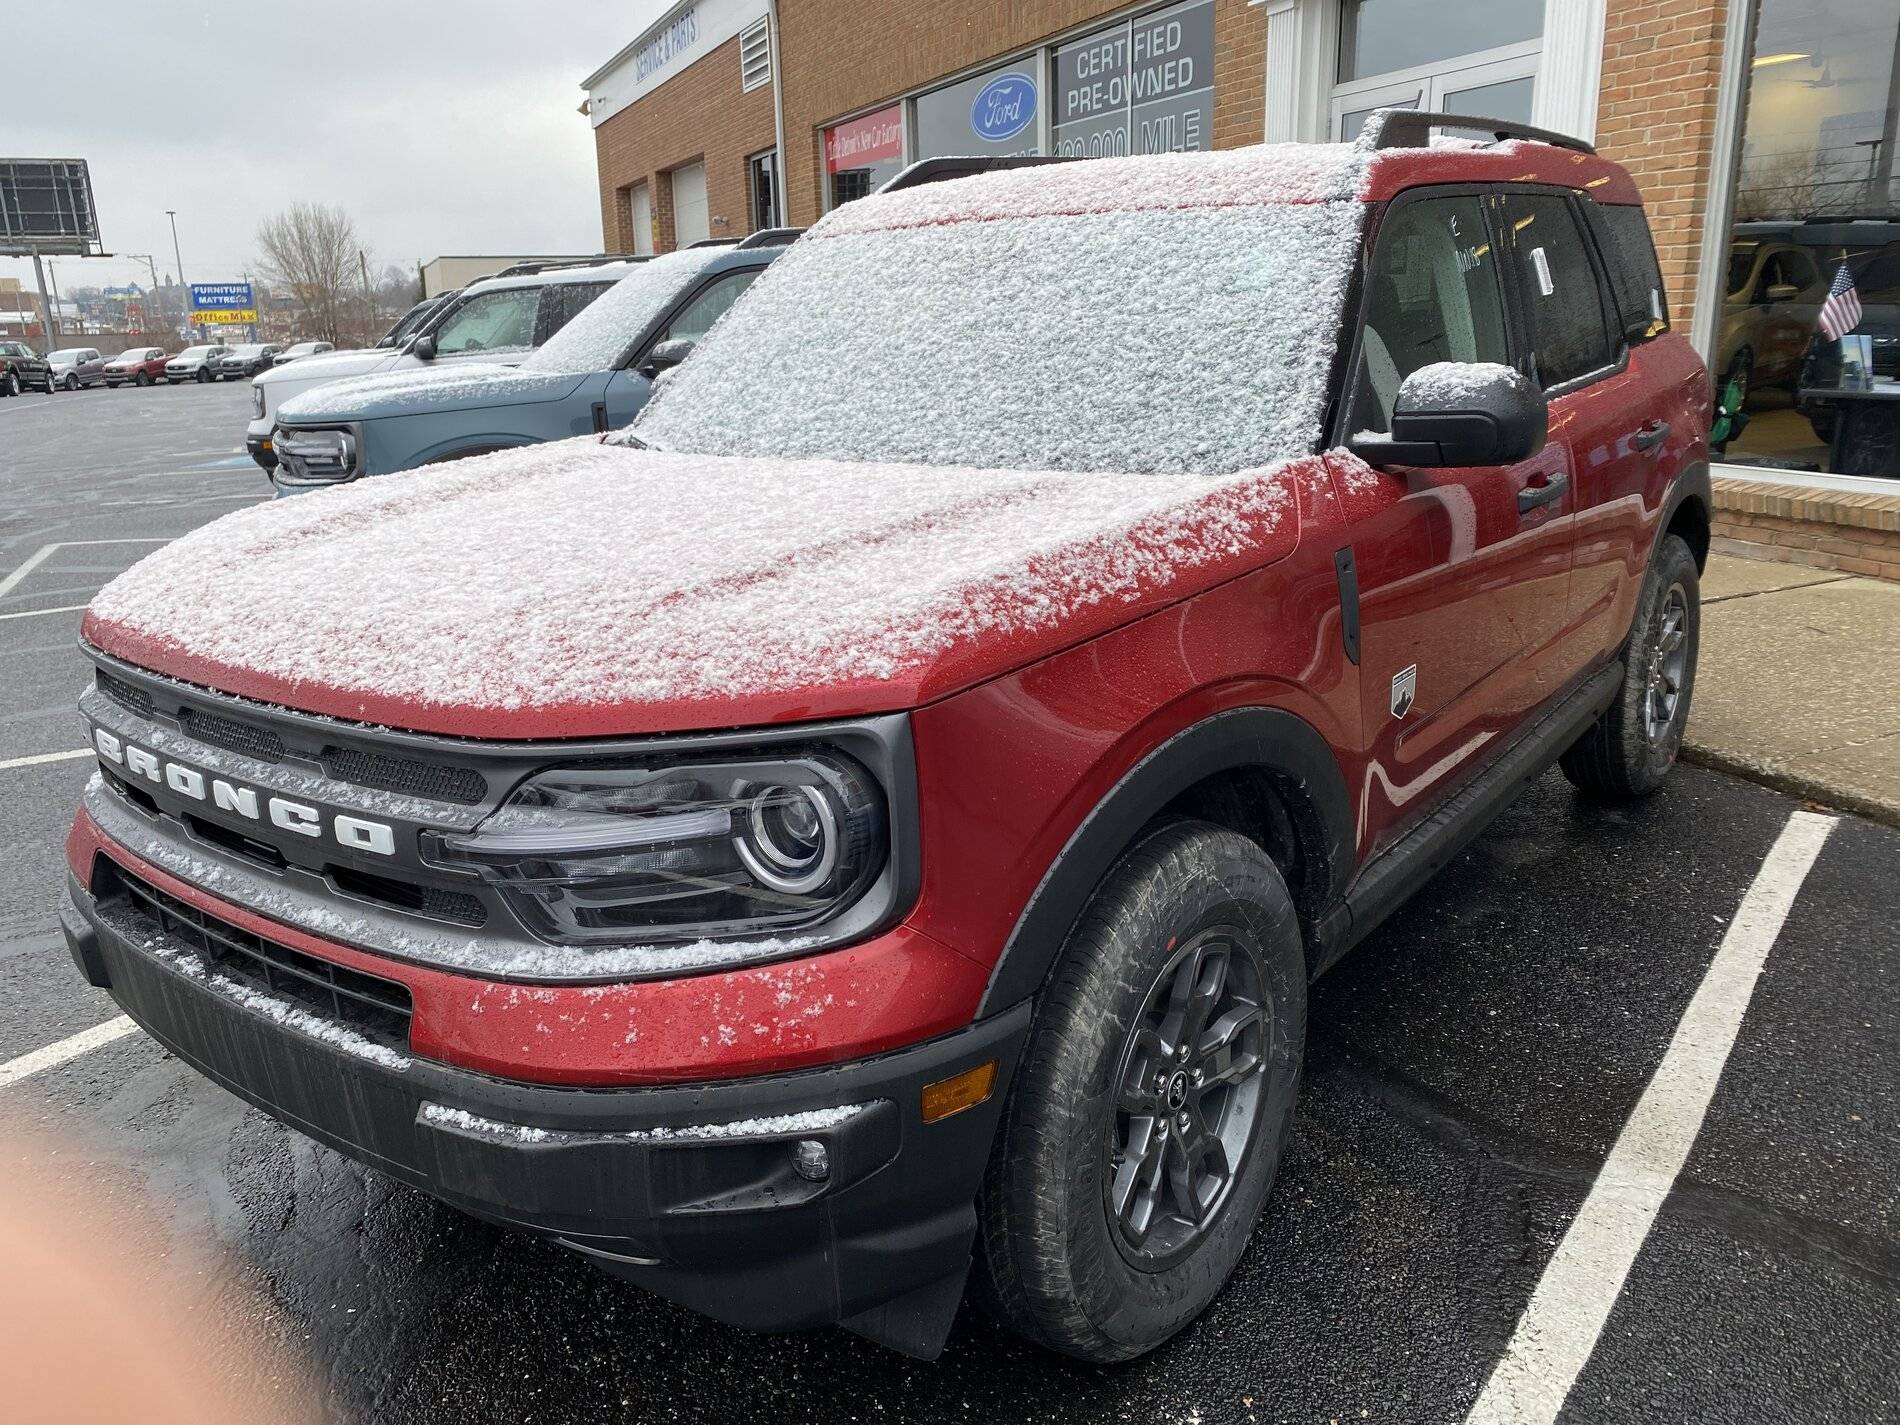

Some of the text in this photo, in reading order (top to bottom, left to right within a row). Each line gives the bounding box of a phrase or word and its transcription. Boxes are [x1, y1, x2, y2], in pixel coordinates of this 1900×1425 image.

[671, 8, 696, 57] PARTS
[1076, 20, 1182, 79] CERTIFIED
[984, 86, 1021, 128] Ford
[1067, 56, 1194, 117] PRE-OWNED
[1053, 109, 1200, 157] 100000 MILE
[194, 286, 248, 294] FURNITURE
[95, 728, 396, 856] BRONCO
